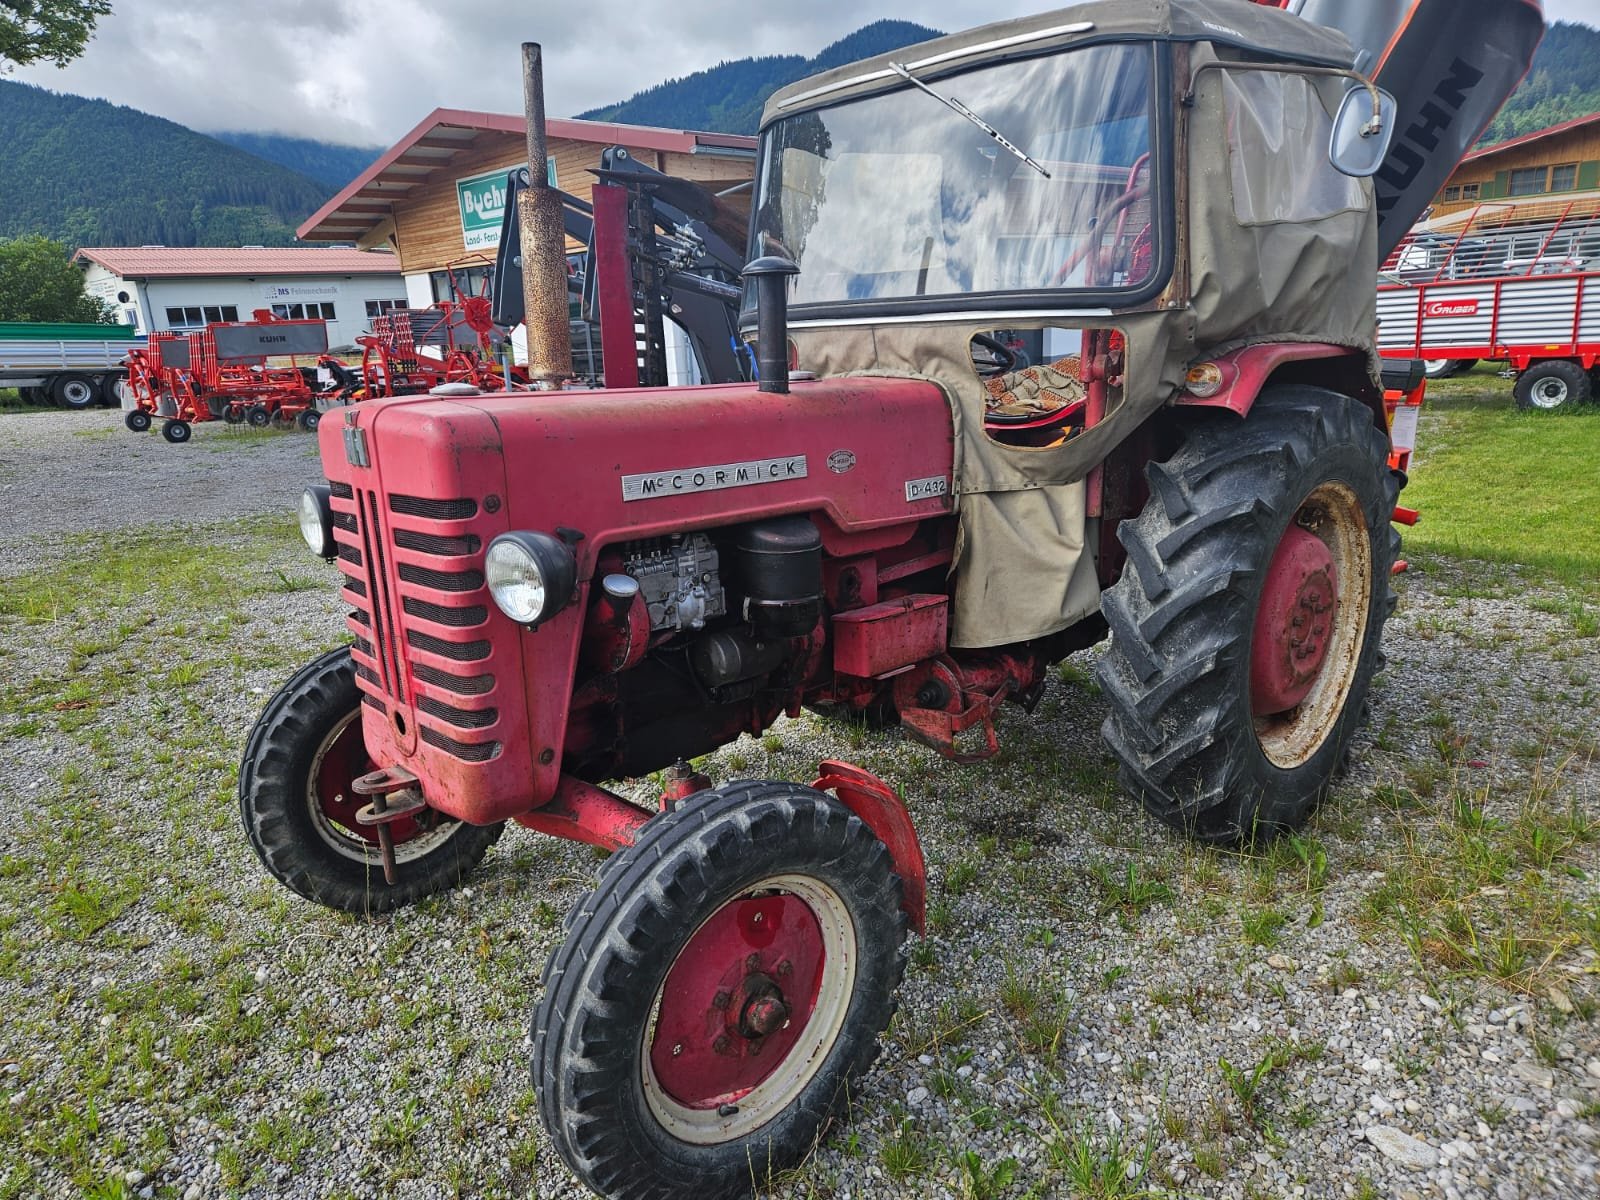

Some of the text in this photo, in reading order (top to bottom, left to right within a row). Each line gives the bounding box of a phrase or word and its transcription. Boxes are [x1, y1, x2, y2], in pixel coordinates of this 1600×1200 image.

[278, 288, 290, 296] MS
[1429, 303, 1475, 314] GRUBER
[259, 335, 287, 343] KUHN
